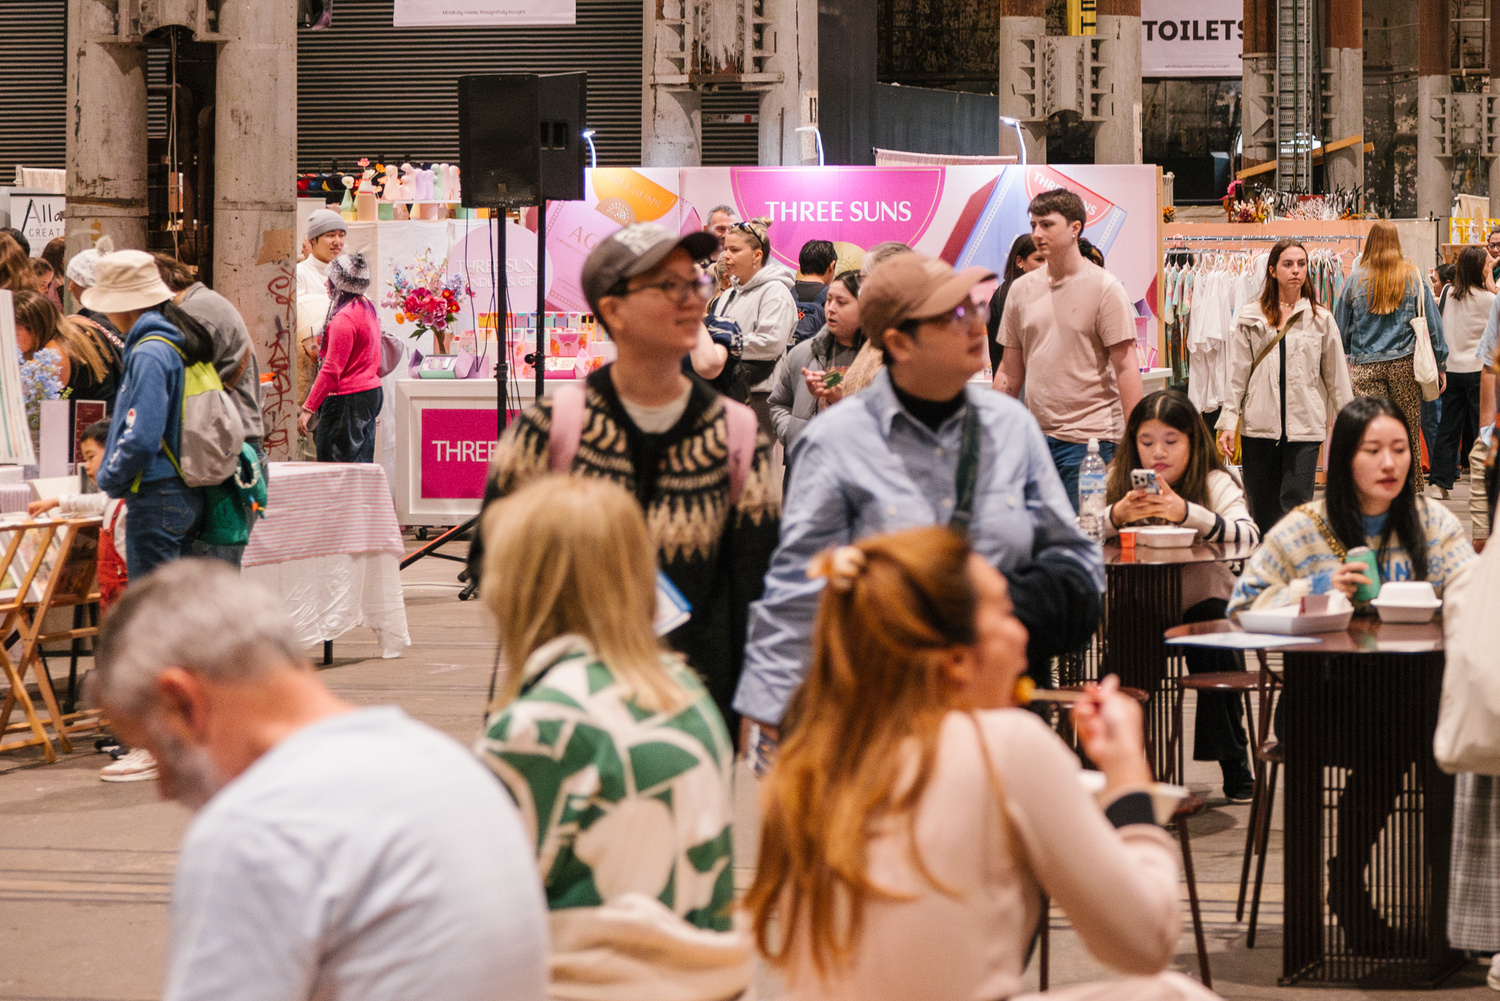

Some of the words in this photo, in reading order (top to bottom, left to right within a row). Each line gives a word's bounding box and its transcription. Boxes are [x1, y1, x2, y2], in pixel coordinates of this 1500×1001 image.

[22, 199, 65, 233] Alla
[765, 201, 844, 222] THREE
[850, 201, 912, 222] SUNS
[28, 228, 65, 238] CREAT
[506, 258, 538, 273] SUN
